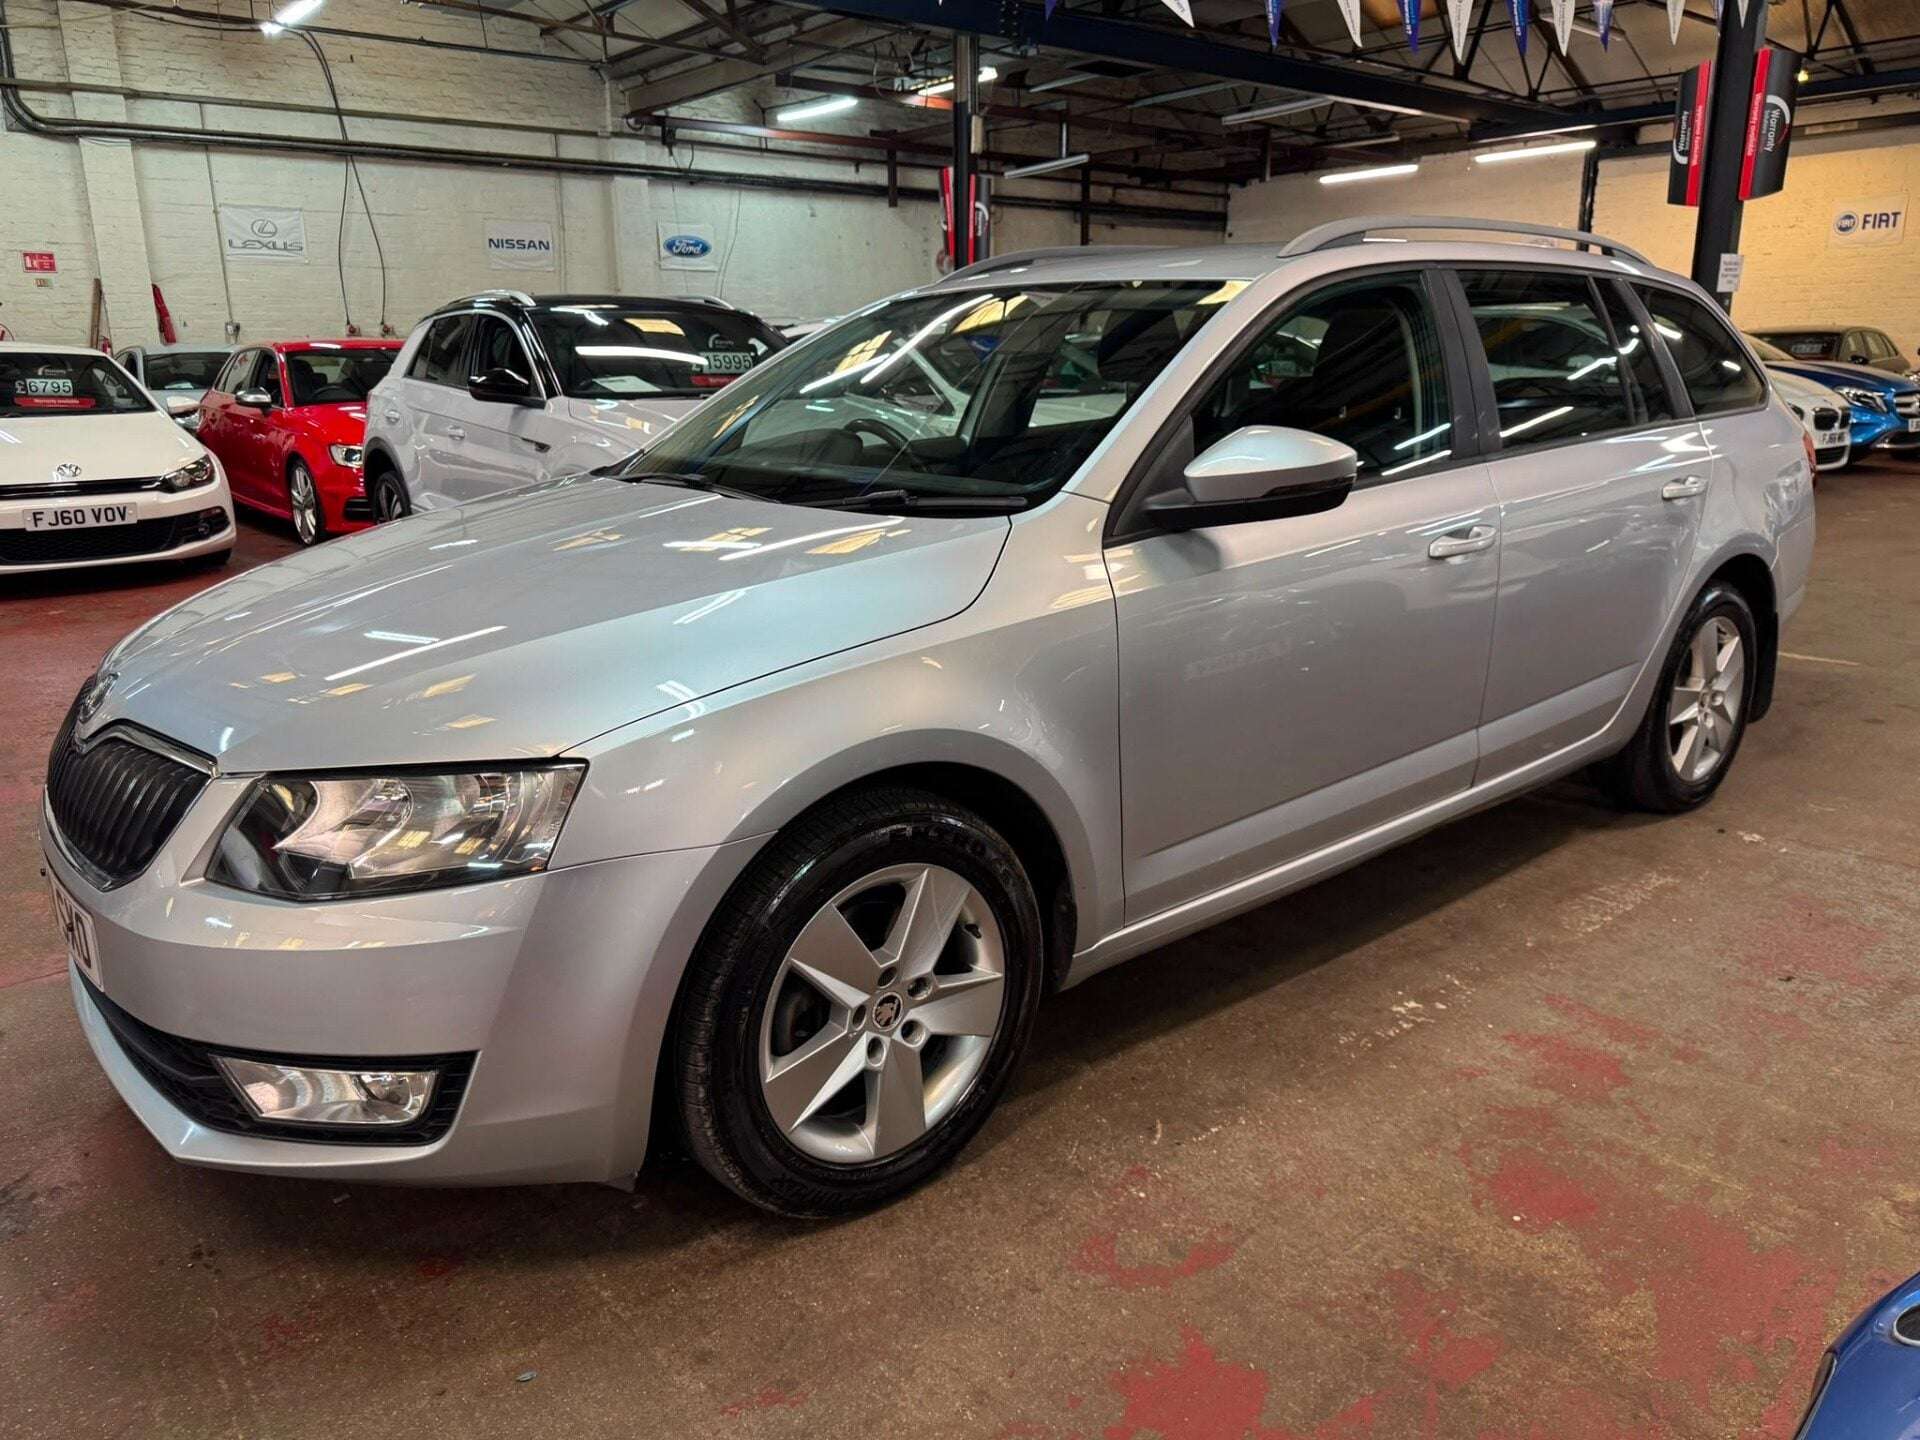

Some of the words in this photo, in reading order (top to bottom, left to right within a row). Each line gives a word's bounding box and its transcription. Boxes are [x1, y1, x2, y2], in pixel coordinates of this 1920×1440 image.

[1678, 111, 1689, 151] Warranty
[1763, 109, 1781, 151] Warranty
[1862, 211, 1902, 230] FIAT
[228, 239, 303, 252] LEXUS
[488, 238, 550, 250] NISSAN
[672, 239, 703, 254] Ford
[32, 509, 86, 528] FJ60
[91, 505, 127, 524] VOV
